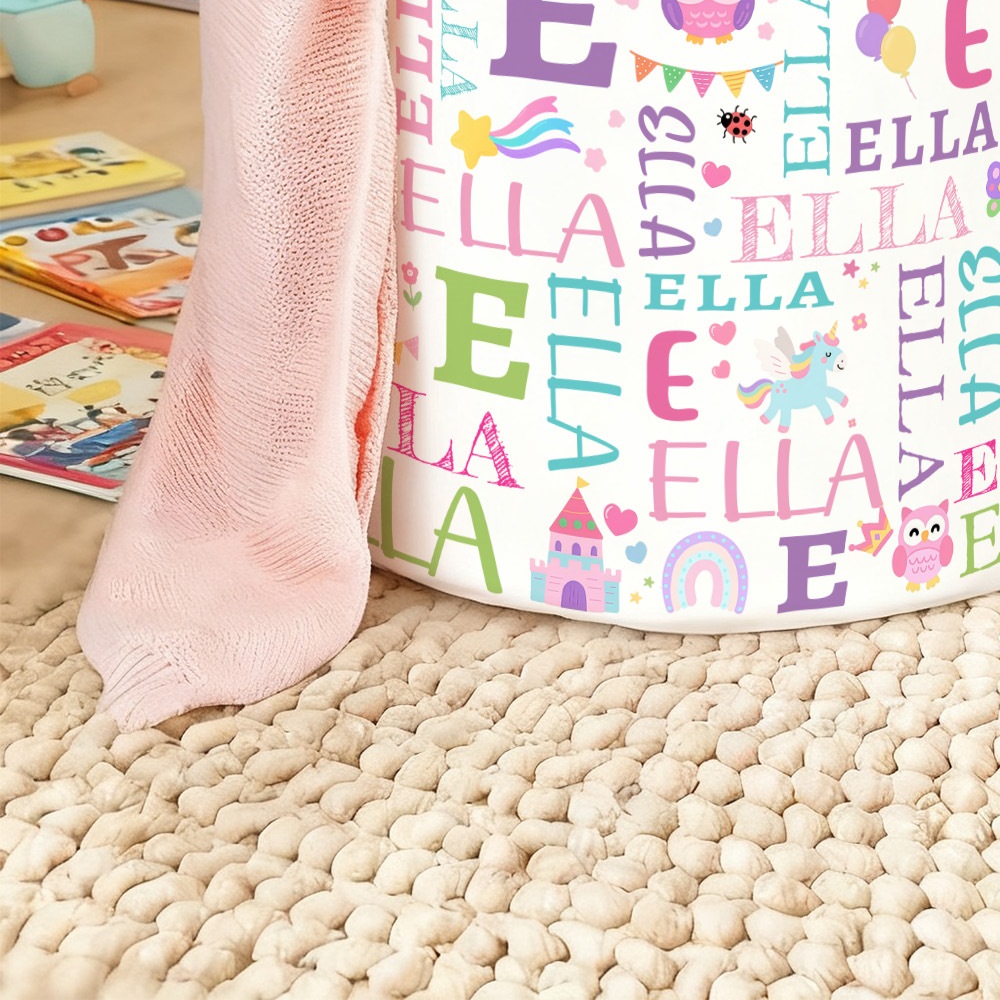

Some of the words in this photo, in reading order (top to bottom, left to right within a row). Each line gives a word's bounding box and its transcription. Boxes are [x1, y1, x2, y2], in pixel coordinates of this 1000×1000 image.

[638, 104, 696, 260] ELLA
[844, 100, 998, 175] ELLA
[400, 158, 625, 268] ELLA
[730, 175, 973, 263] ELLA
[433, 265, 530, 400] E
[644, 270, 834, 312] ELLA
[547, 272, 621, 471] ELLA
[646, 330, 699, 421] E
[898, 255, 945, 502] ELLA
[386, 381, 525, 490] LA
[648, 433, 884, 522] ELLA
[367, 455, 503, 594] LA
[777, 529, 848, 614] E
